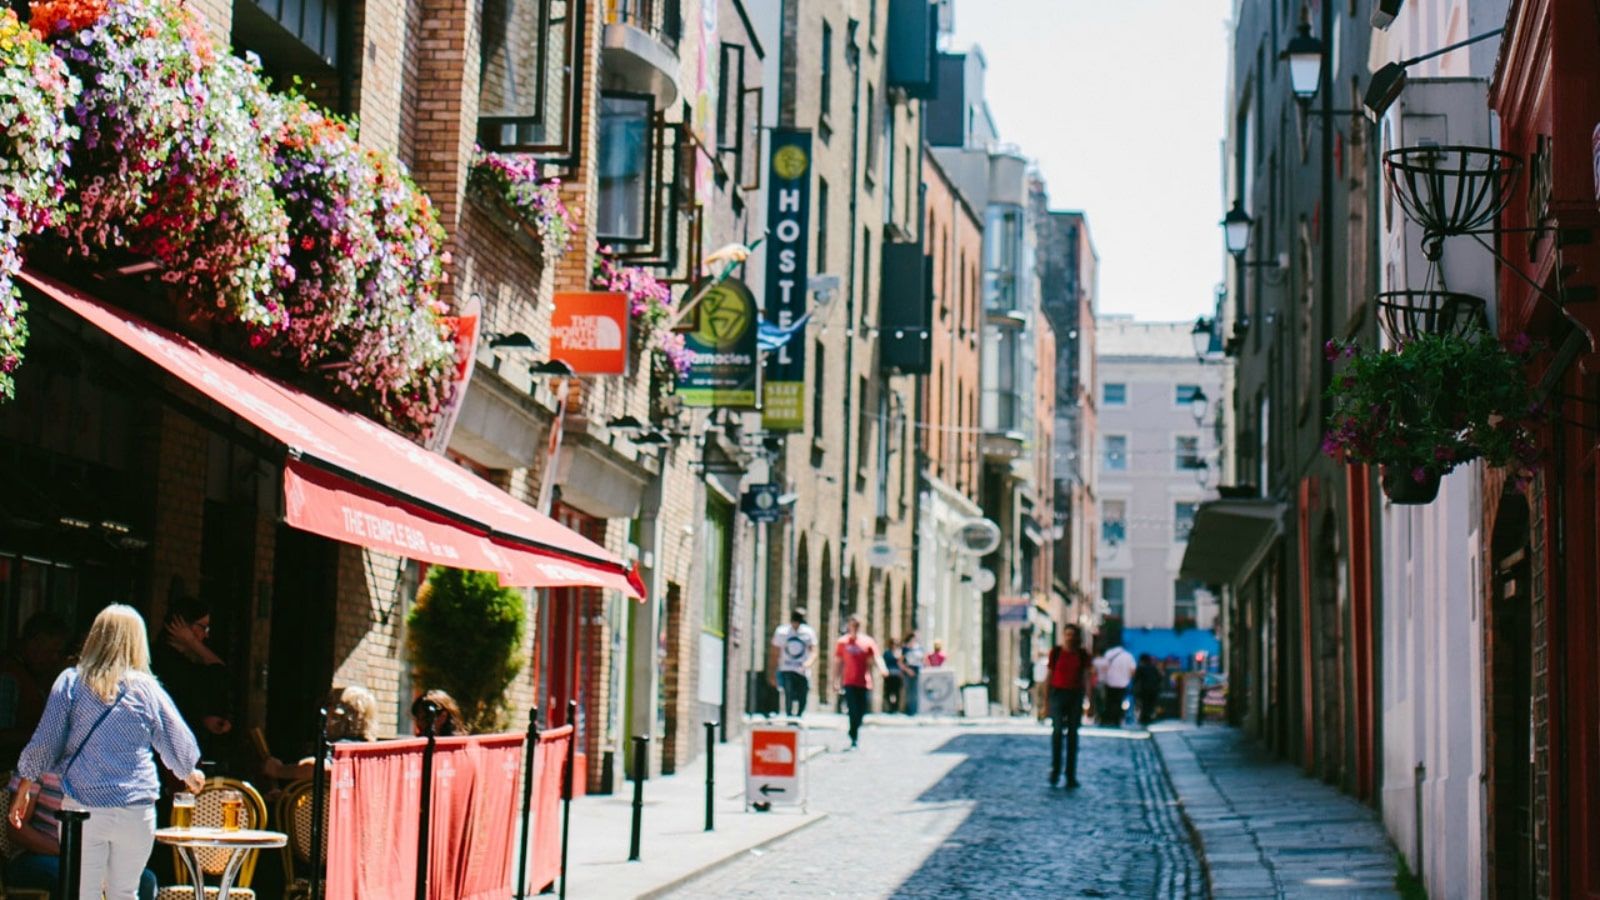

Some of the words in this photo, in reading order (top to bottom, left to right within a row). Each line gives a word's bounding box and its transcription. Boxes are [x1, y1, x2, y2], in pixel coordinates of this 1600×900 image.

[776, 189, 800, 364] HOSTEL
[570, 314, 596, 327] THE
[549, 326, 596, 339] NORTH
[561, 337, 597, 351] FACE
[691, 352, 752, 365] arnacles
[341, 506, 367, 537] THE
[364, 513, 407, 547] TEMPLE
[404, 524, 431, 554] BAR
